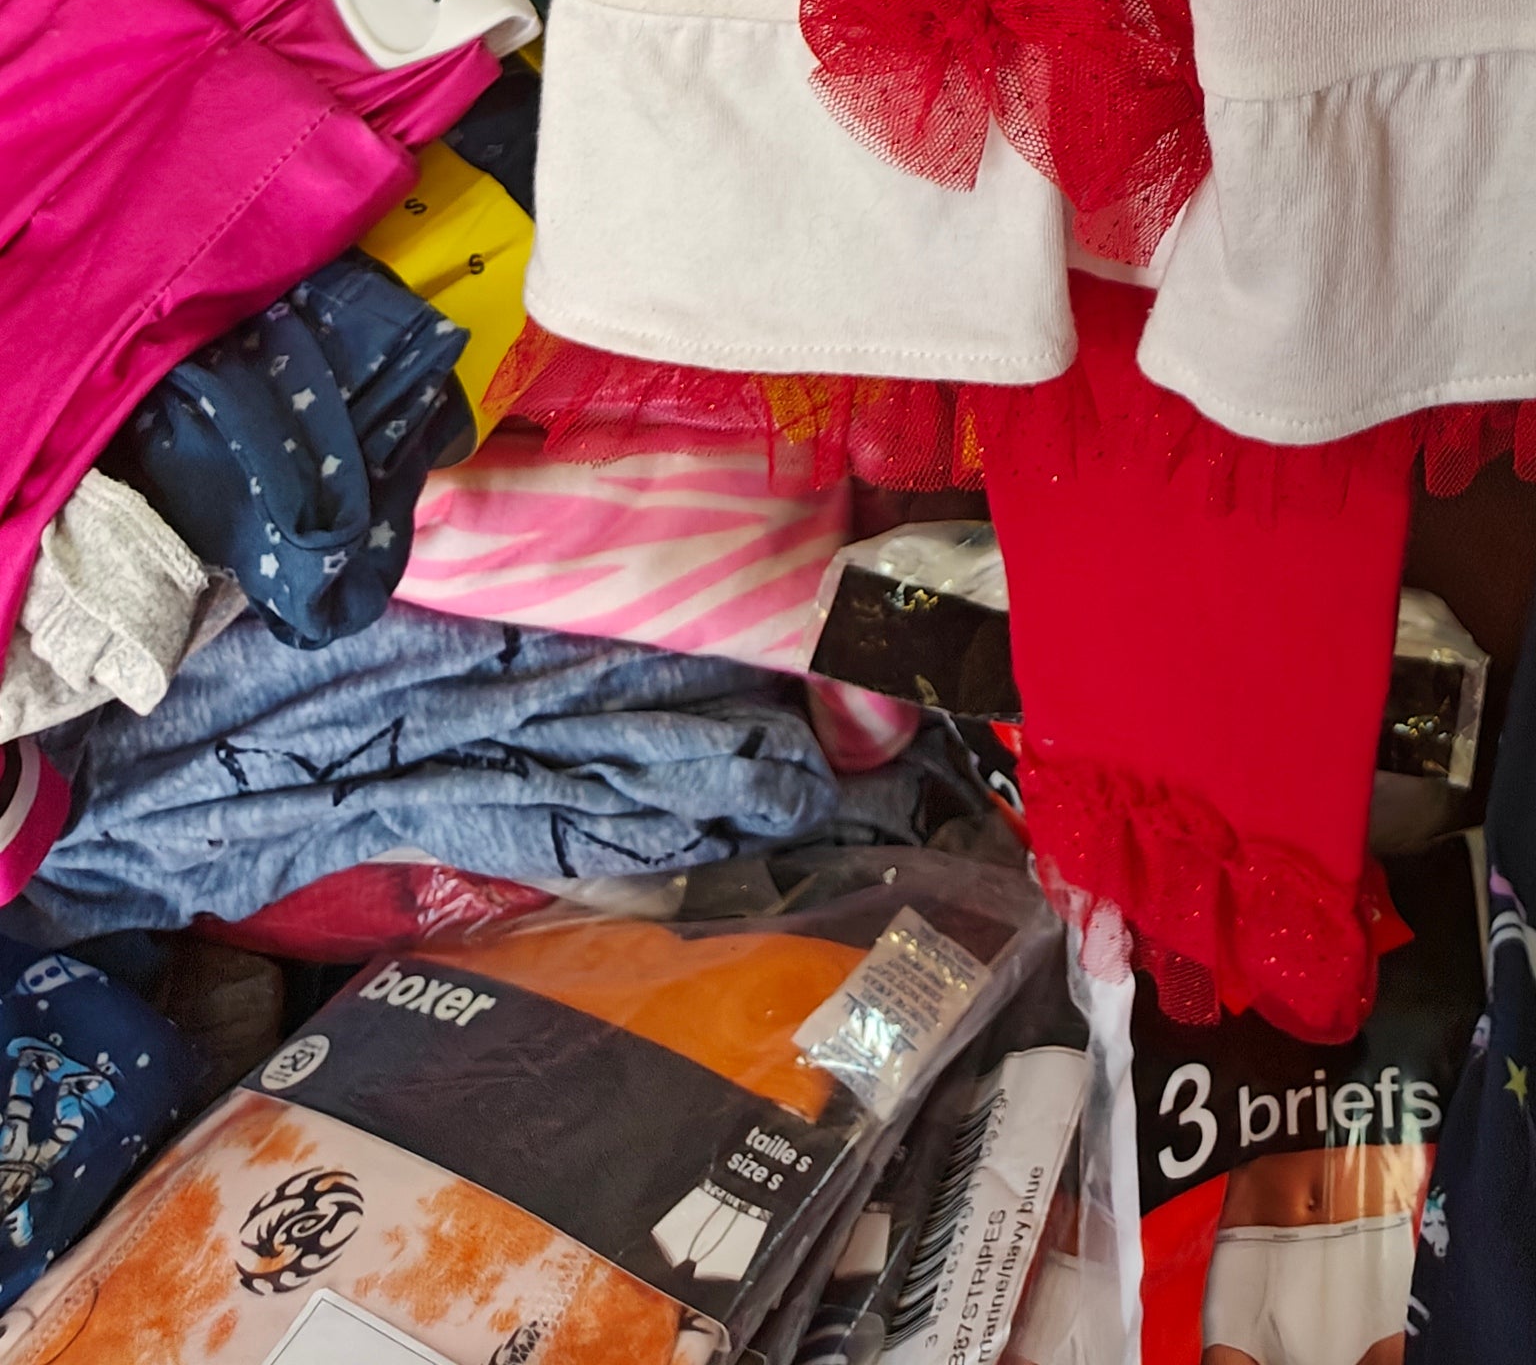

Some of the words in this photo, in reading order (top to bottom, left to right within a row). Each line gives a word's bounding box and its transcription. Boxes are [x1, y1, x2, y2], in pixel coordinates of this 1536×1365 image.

[404, 198, 428, 216] S
[468, 253, 485, 275] S
[359, 961, 496, 1027] boxer
[1158, 1063, 1218, 1180] 3
[1238, 1066, 1442, 1148] briefs
[727, 1152, 768, 1183] size
[767, 1173, 784, 1191] s
[745, 1125, 798, 1165] taille
[795, 1155, 813, 1173] s
[979, 1220, 1032, 1363] marine/navy
[1016, 1165, 1044, 1214] blue
